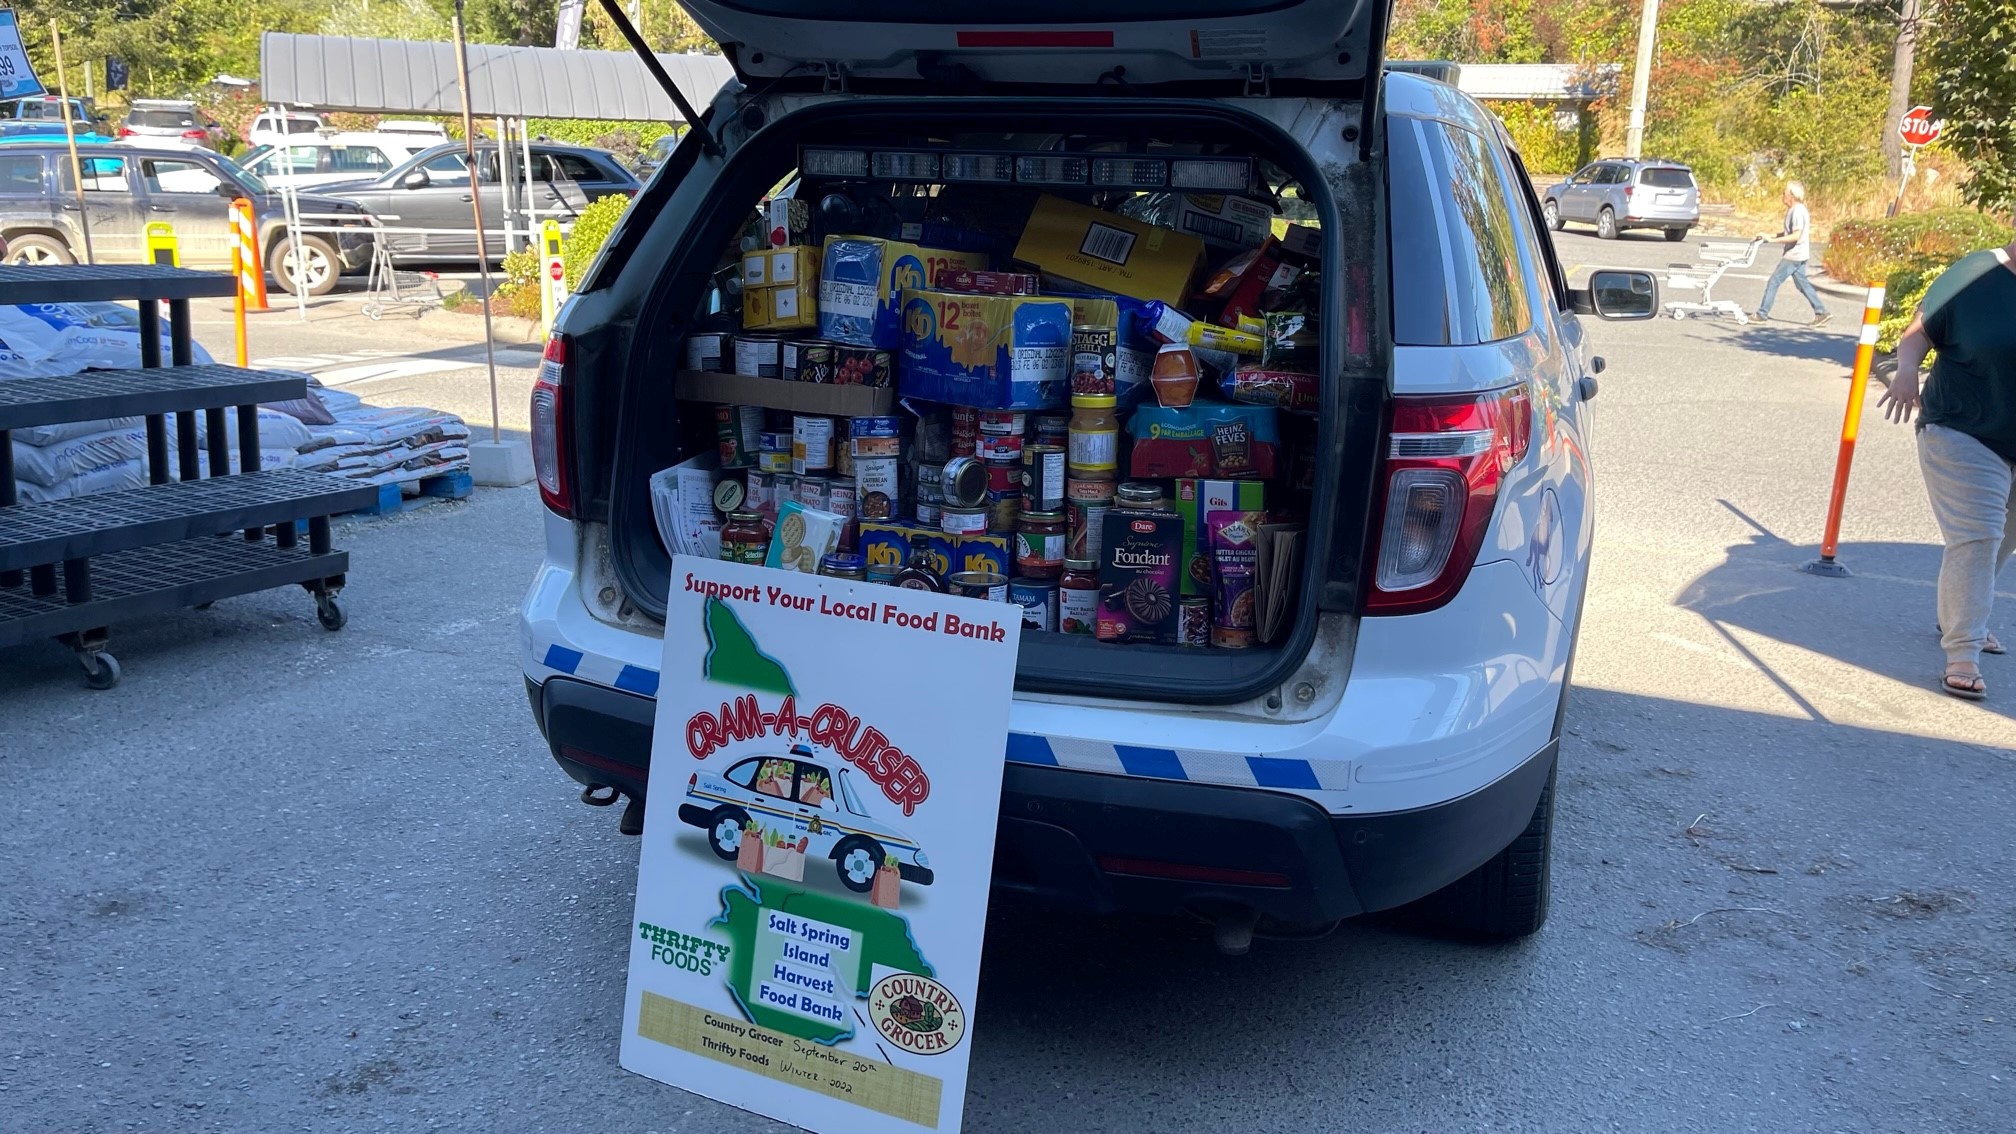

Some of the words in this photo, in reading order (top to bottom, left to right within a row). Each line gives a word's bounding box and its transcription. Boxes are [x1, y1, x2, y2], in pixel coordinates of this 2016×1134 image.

[1901, 117, 1940, 136] STOP
[938, 301, 960, 330] 12
[1072, 333, 1109, 347] STAGG
[1075, 344, 1101, 353] CHILI
[1150, 423, 1161, 440] 9
[1172, 428, 1204, 438] EMBALLAGE
[1217, 423, 1243, 436] HEINZ
[831, 501, 855, 510] TOMATO
[832, 490, 853, 500] HEINZ
[1134, 522, 1153, 531] Dare
[867, 542, 902, 566] KD
[965, 553, 999, 574] KD
[1114, 547, 1171, 566] Fondant
[685, 572, 760, 604] Support
[767, 586, 815, 612] Your
[820, 596, 876, 622] Local
[883, 605, 937, 632] Food
[944, 612, 1006, 643] Bank
[1013, 593, 1036, 603] TAMAM
[686, 693, 931, 817] CRAM-A-CRUISER
[639, 921, 730, 962] THRIFTY
[769, 914, 797, 934] Salt
[801, 922, 850, 950] Spring
[651, 944, 712, 976] FOODS
[783, 942, 830, 968] Island
[773, 964, 834, 994] Harvest
[759, 984, 797, 1008] Food
[801, 996, 843, 1021] Bank
[881, 978, 958, 1015] COUNTRY
[704, 1014, 746, 1038] Country
[749, 1028, 784, 1047] Grocer
[881, 1017, 949, 1050] GROCER
[702, 1036, 737, 1057] Thrifty
[739, 1048, 770, 1066] Foods
[793, 1039, 847, 1066] September
[829, 1079, 853, 1094] 2022
